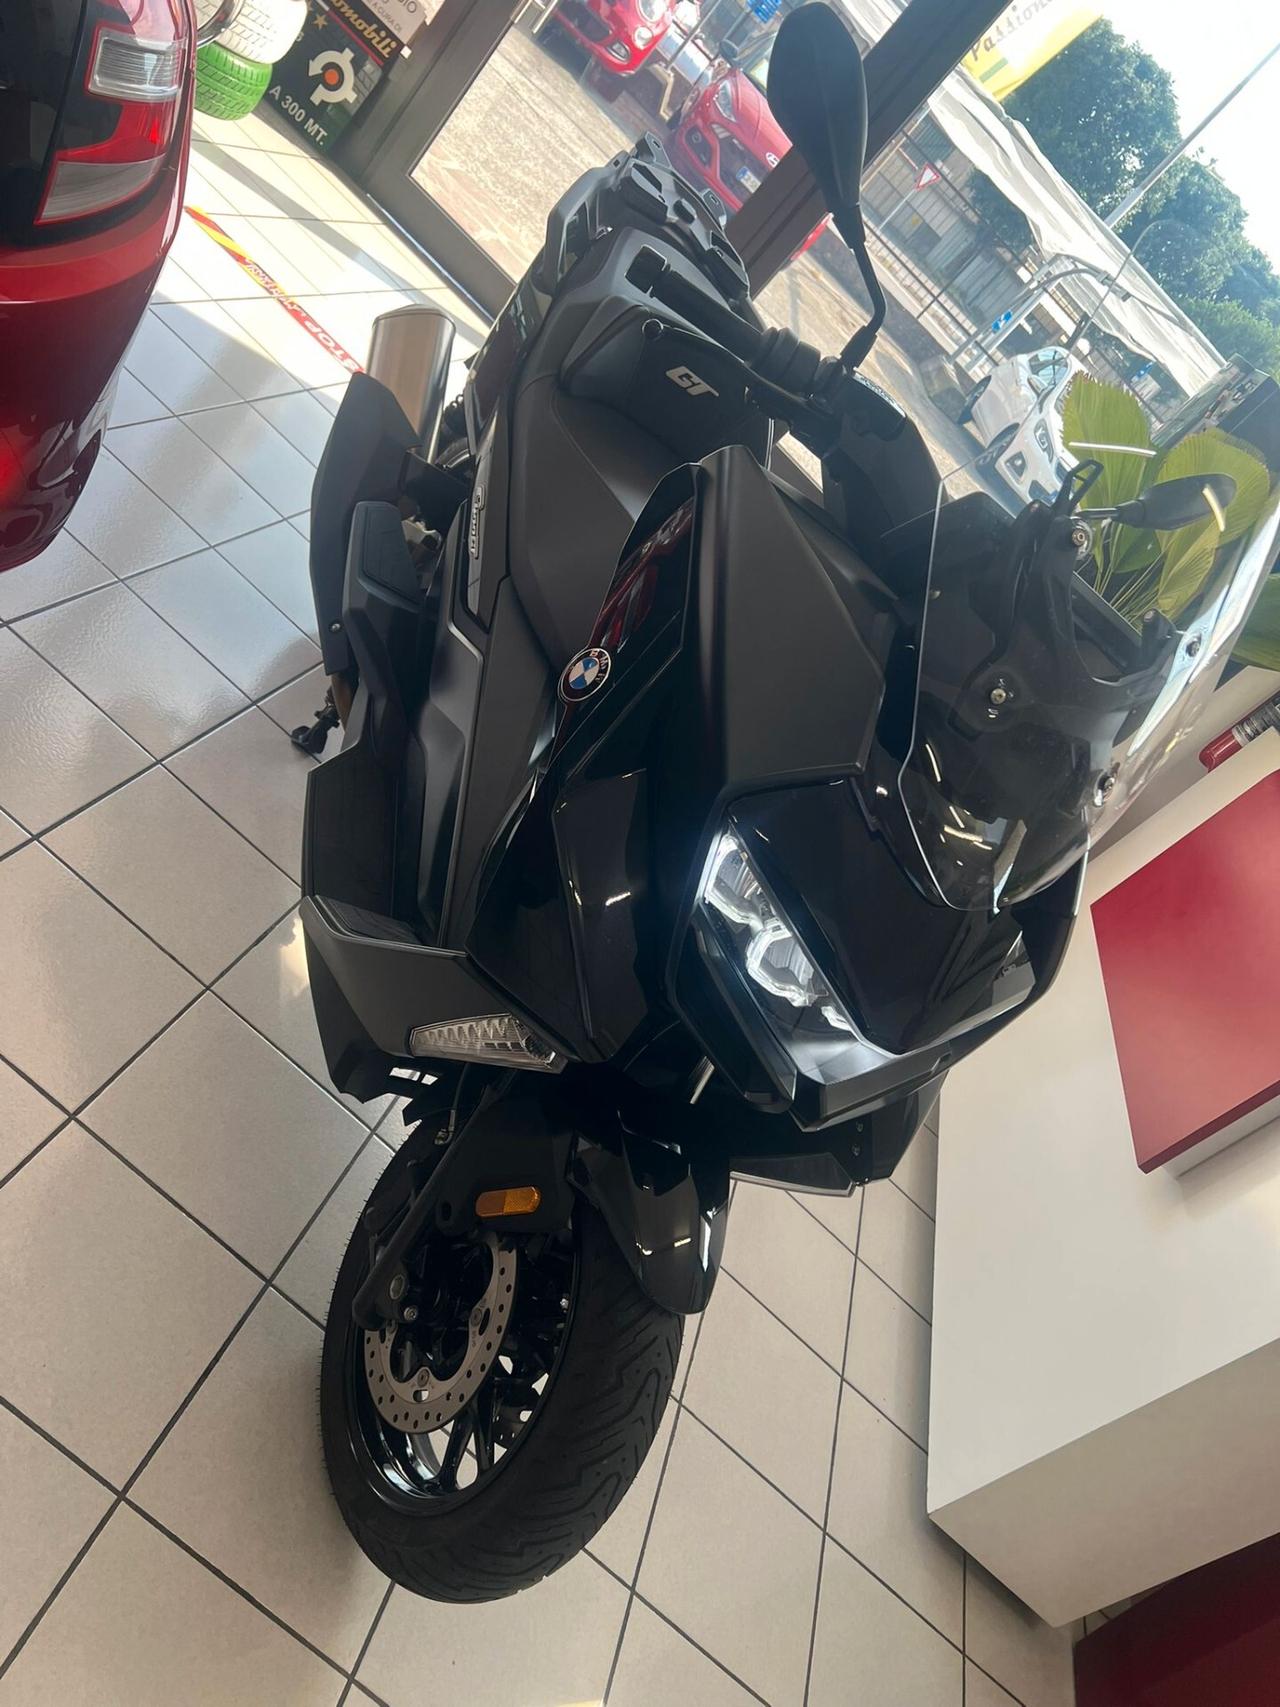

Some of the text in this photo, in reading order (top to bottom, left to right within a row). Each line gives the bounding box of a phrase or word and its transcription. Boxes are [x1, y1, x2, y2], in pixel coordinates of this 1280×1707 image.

[269, 85, 328, 146] A 300 MT.
[665, 365, 720, 397] GT
